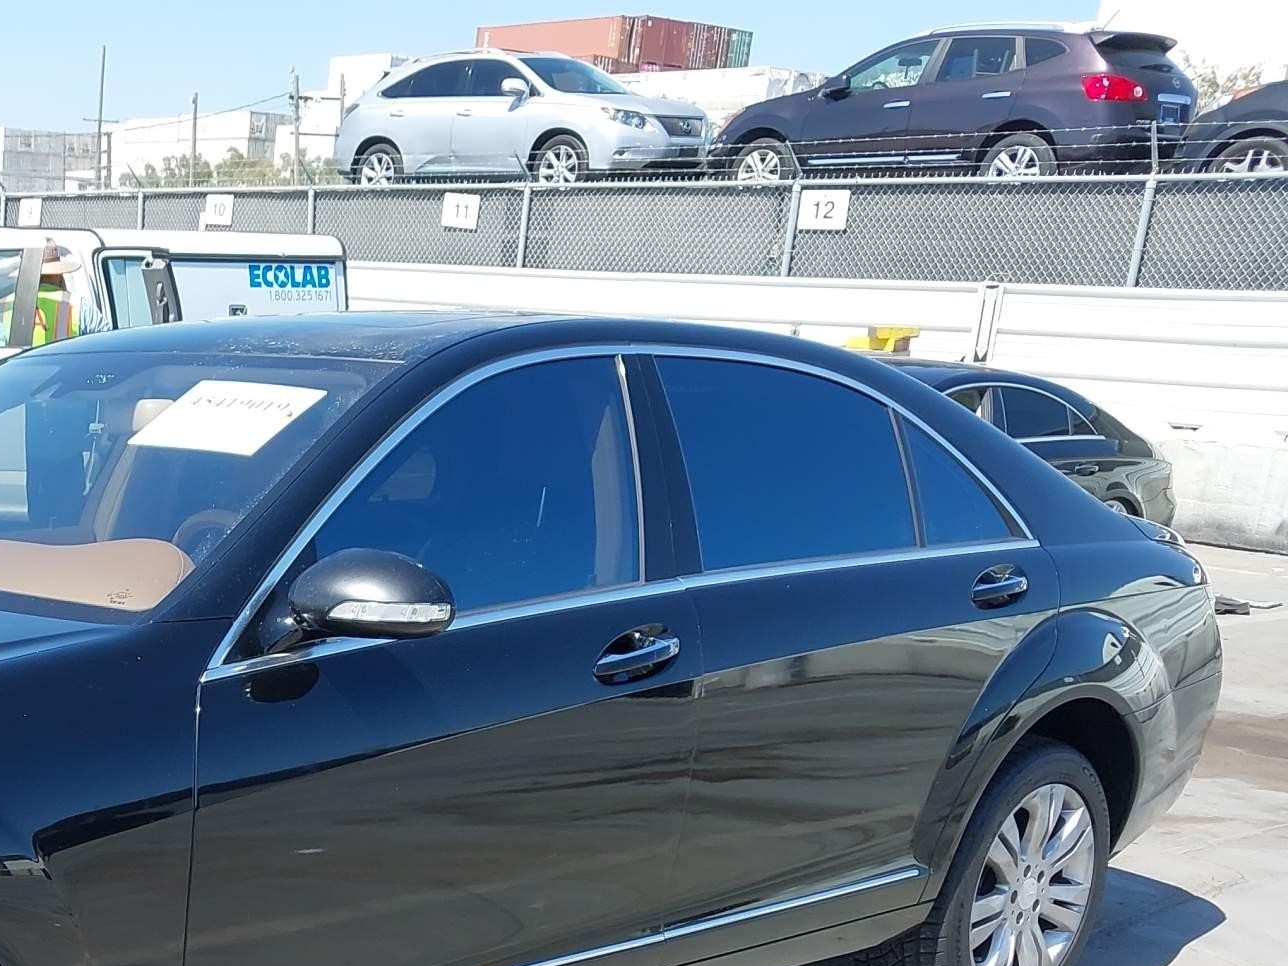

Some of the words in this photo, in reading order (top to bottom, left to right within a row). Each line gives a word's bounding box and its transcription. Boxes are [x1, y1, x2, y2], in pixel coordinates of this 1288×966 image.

[213, 203, 226, 217] 10
[454, 203, 470, 220] 11
[813, 200, 835, 219] 12
[248, 264, 331, 289] ECOLAB
